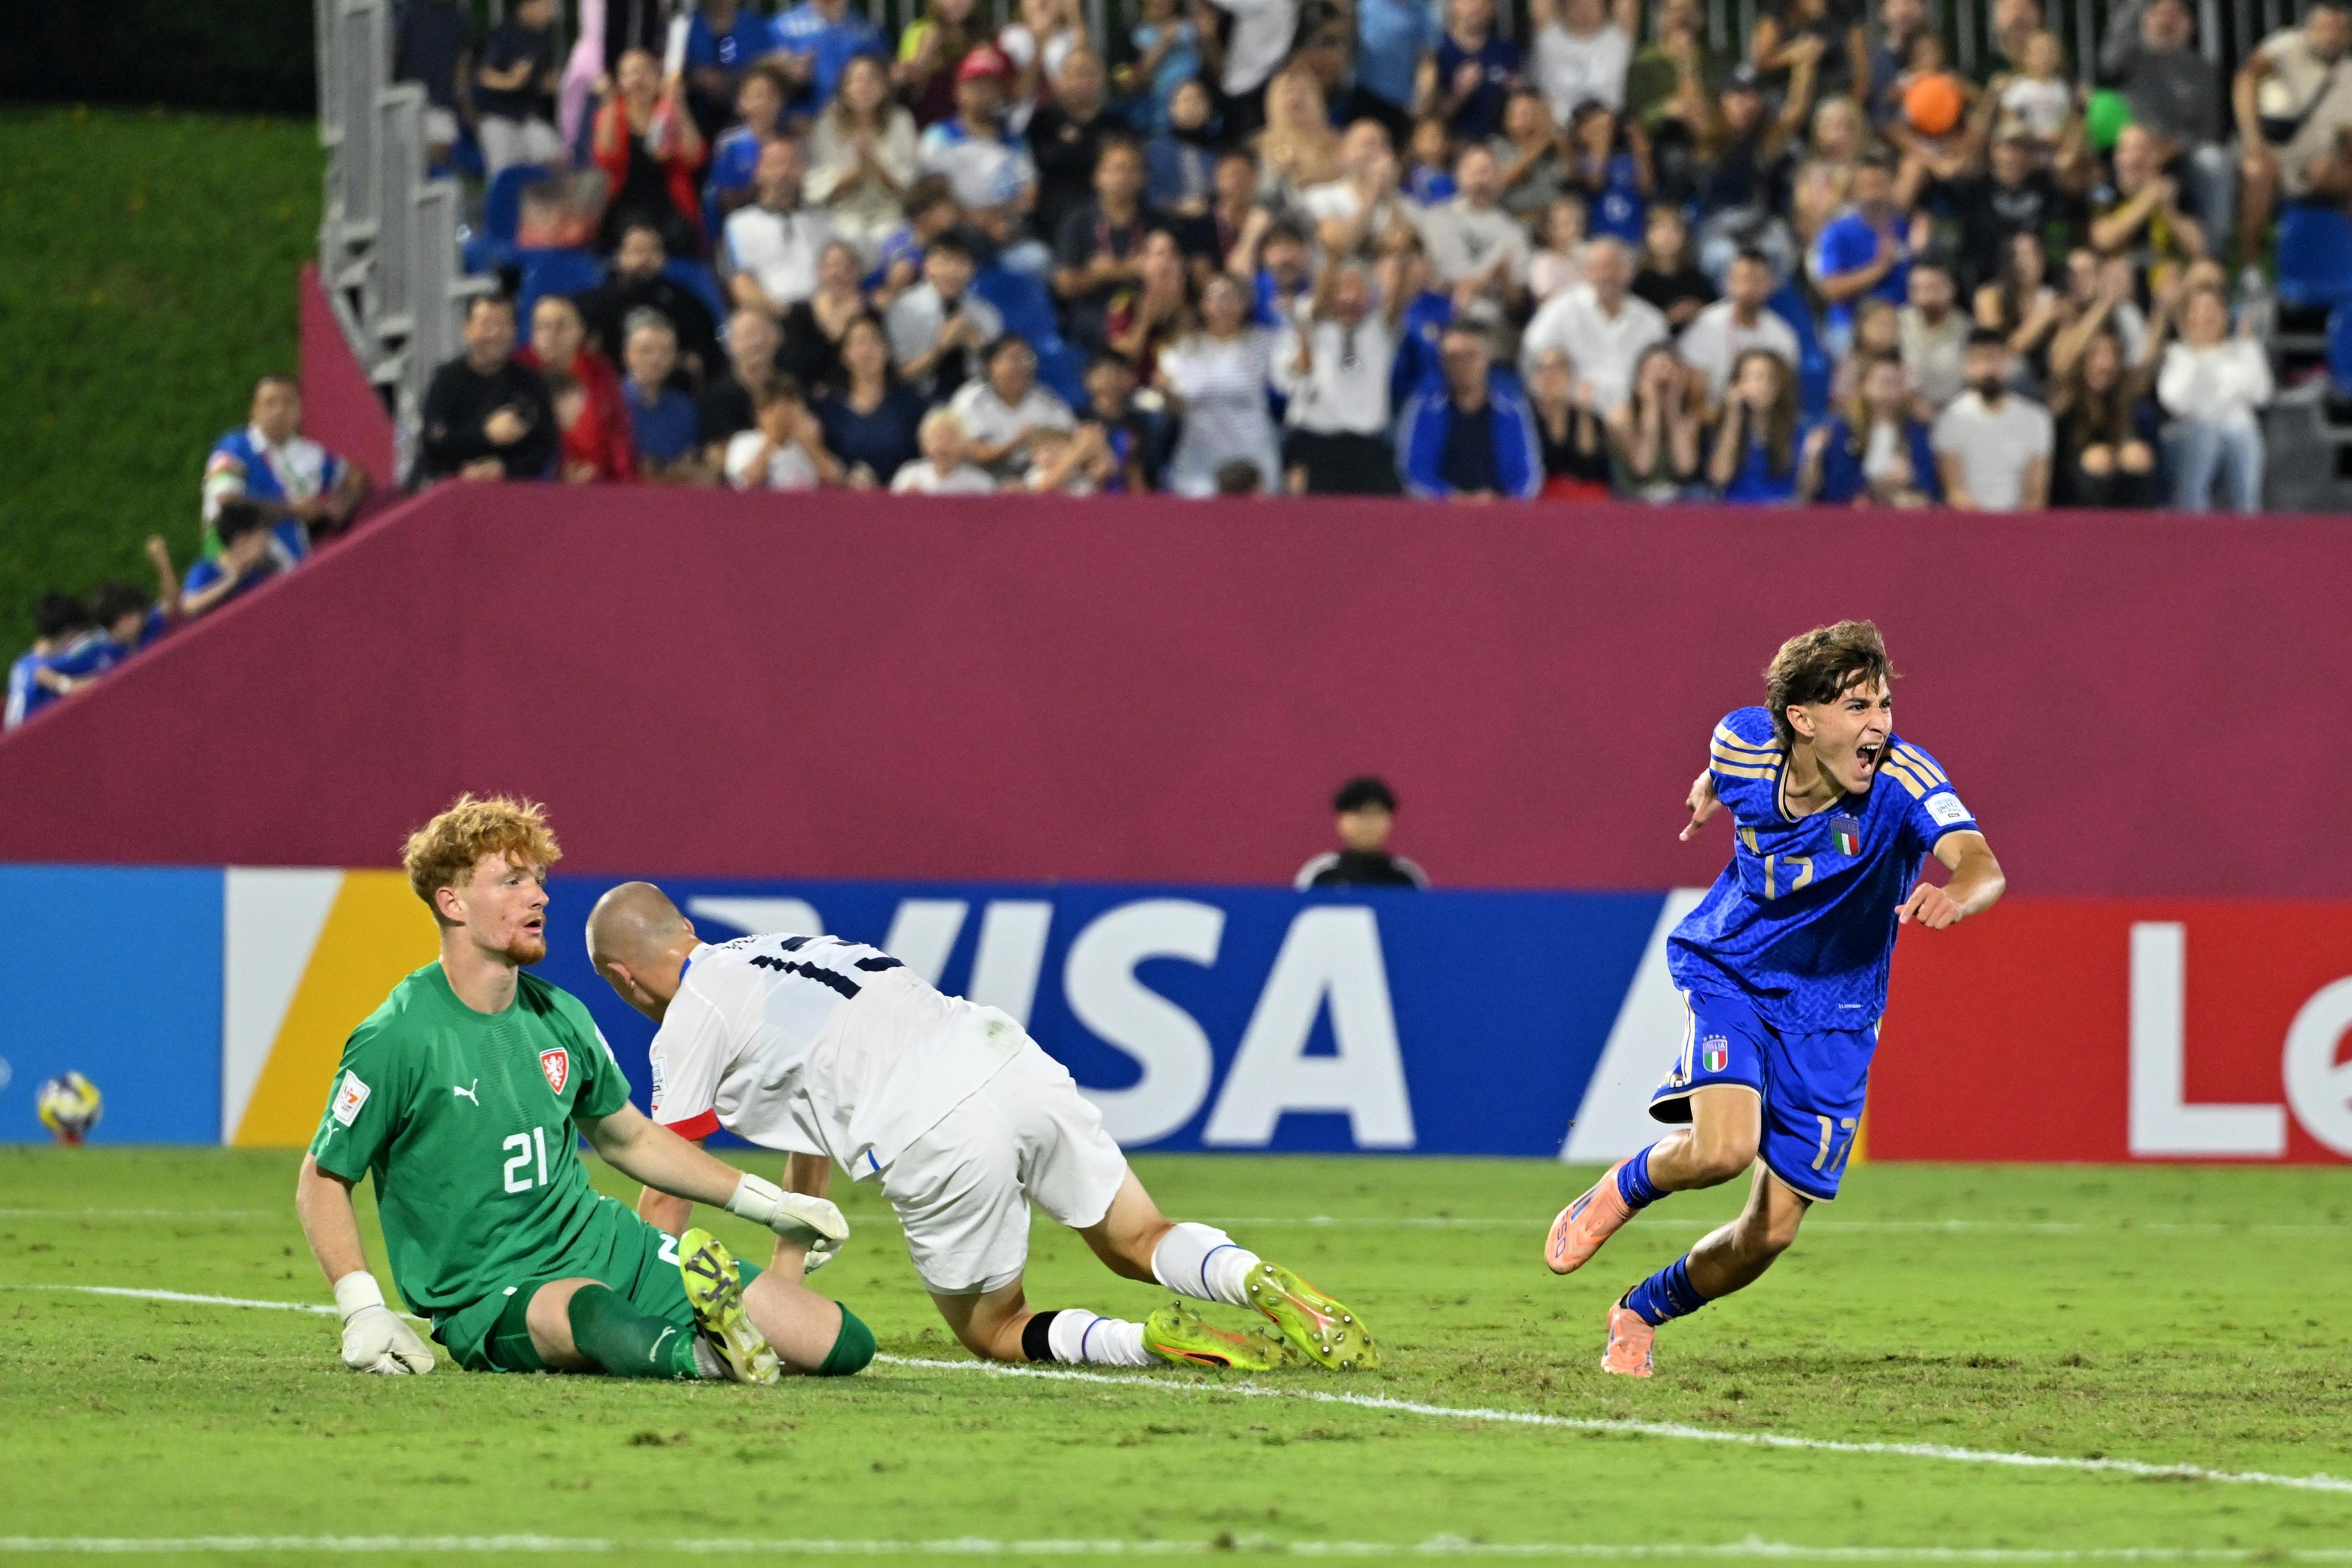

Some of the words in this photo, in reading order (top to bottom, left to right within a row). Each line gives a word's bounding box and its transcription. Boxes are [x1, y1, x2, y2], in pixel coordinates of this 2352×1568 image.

[1765, 854, 1813, 900] 17
[1704, 1041, 1725, 1051] ITALIA
[503, 1126, 548, 1194] 21
[1812, 1115, 1856, 1172] 17
[658, 1233, 680, 1267] 2
